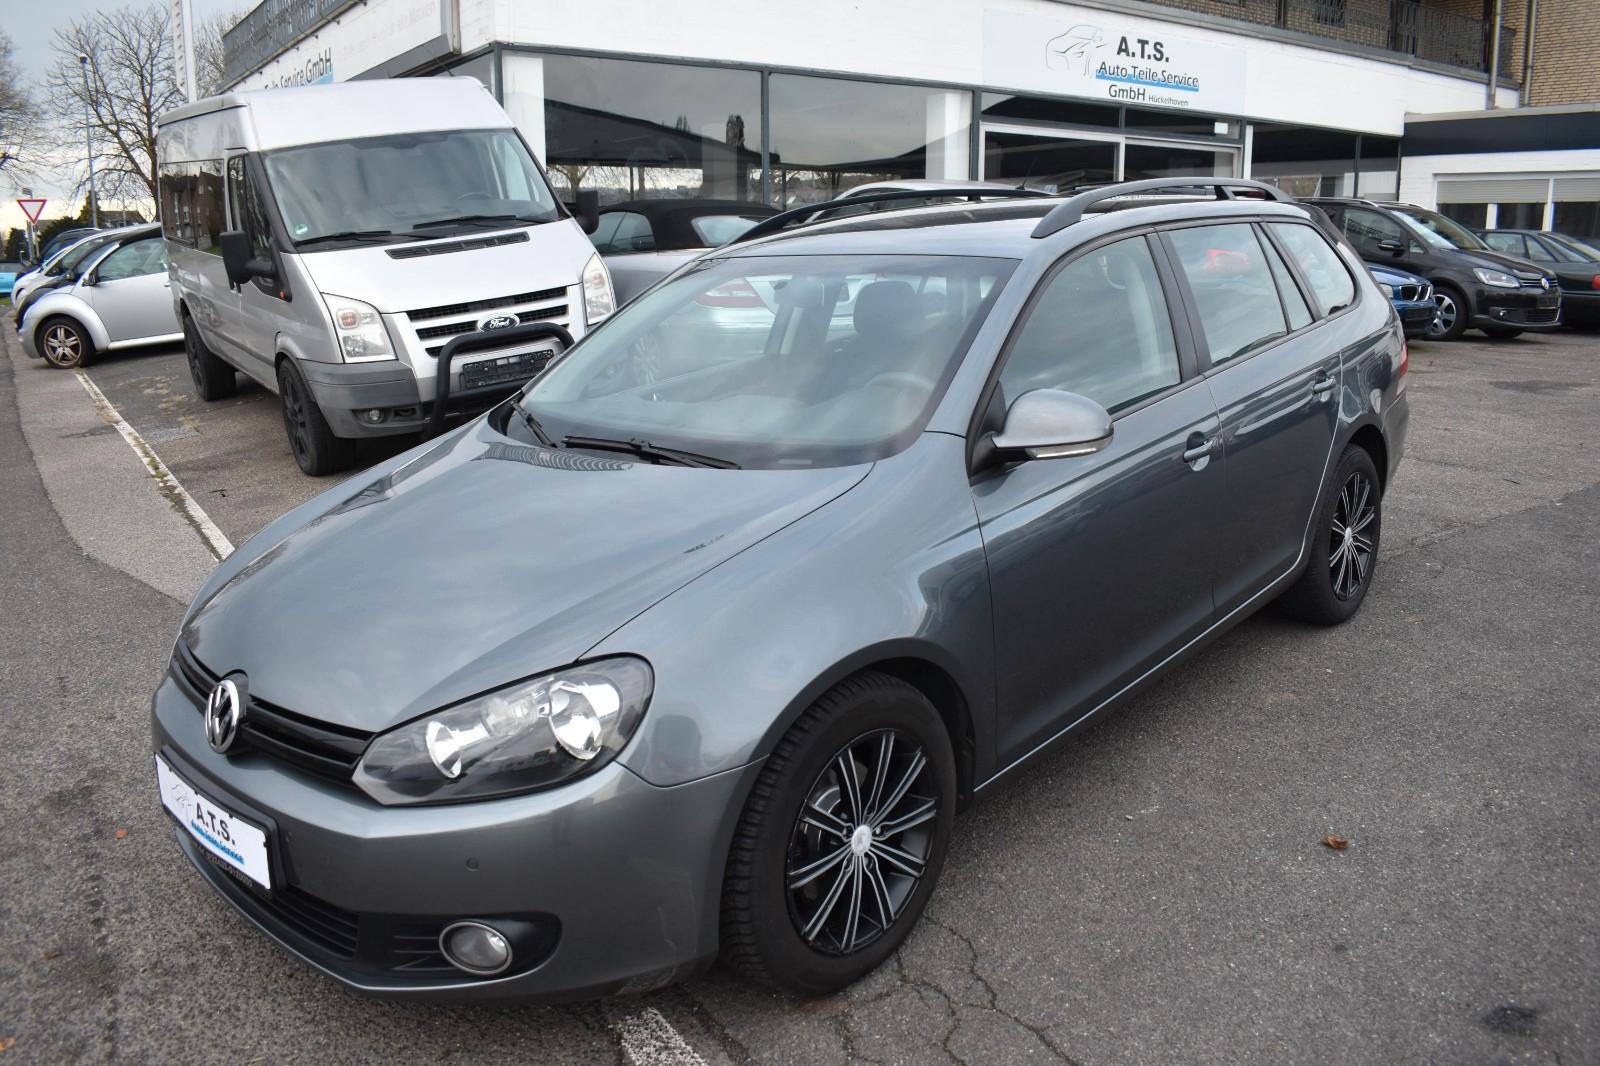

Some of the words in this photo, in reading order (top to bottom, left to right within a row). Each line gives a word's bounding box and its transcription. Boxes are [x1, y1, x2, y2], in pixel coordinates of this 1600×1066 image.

[1116, 36, 1170, 62] A.T.S.
[305, 47, 332, 83] GmbH
[1098, 61, 1128, 78] Auto
[1130, 65, 1158, 82] Teile
[1161, 70, 1199, 88] Service
[1108, 84, 1146, 101] GmbH
[1148, 95, 1189, 106] Hückelhoven
[489, 318, 510, 329] Ford
[196, 802, 236, 845] A.T.S.
